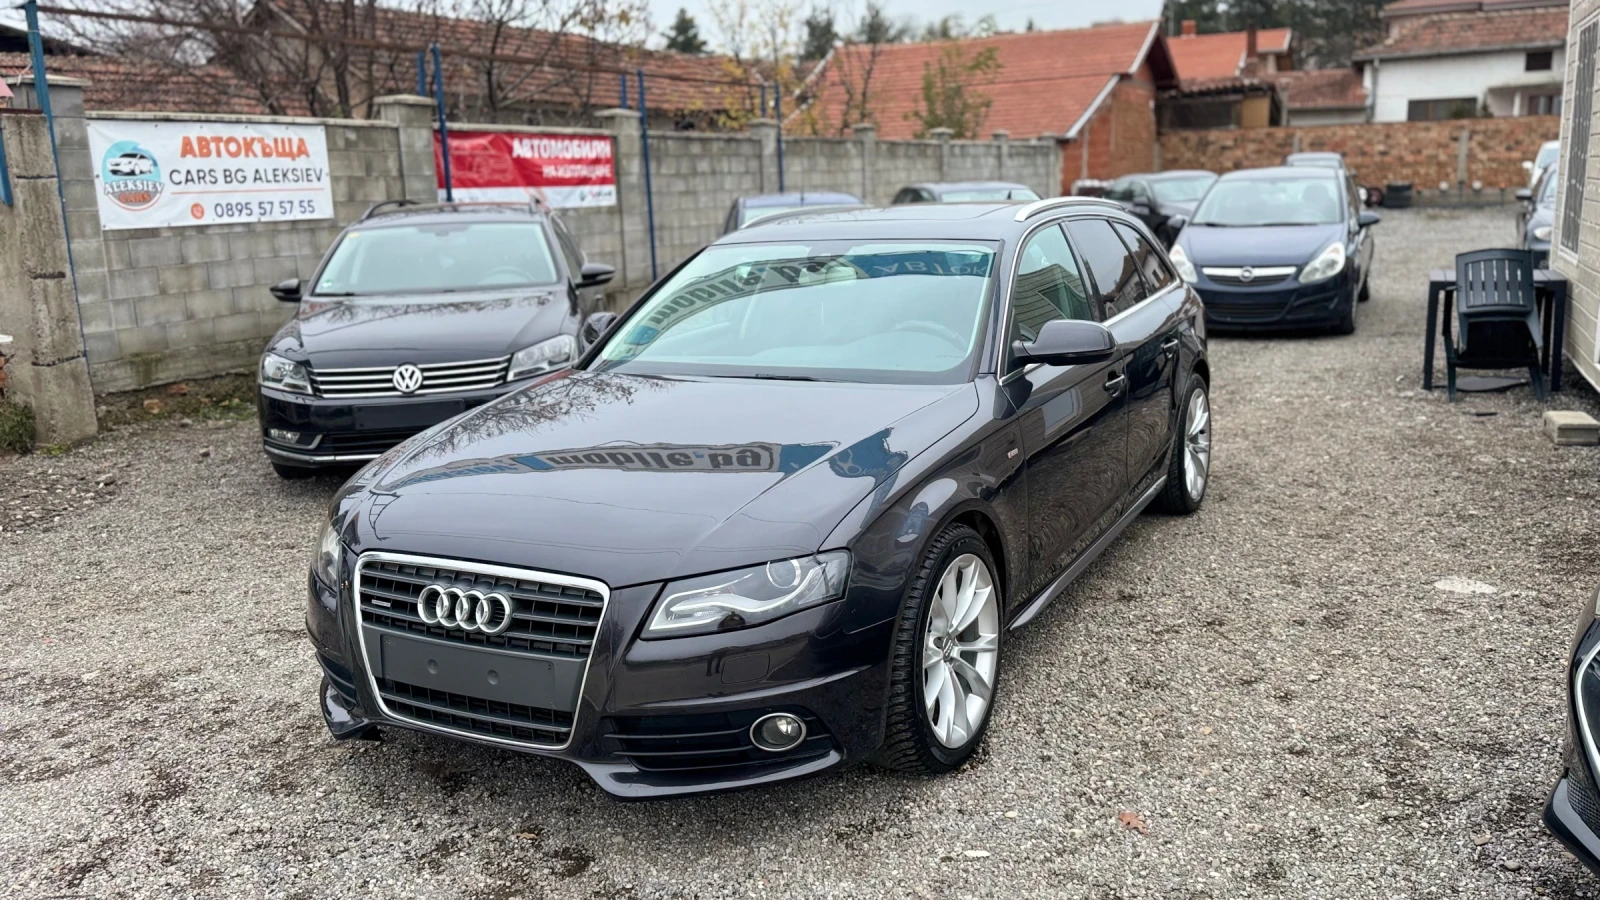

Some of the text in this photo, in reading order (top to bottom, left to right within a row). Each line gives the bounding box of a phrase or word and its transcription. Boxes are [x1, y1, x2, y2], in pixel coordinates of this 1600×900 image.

[180, 136, 310, 161] АВТОКЪЩА
[512, 138, 611, 159] АВТОМОБИЛИ
[169, 168, 323, 186] CARS BG ALEKSIEV
[104, 179, 164, 195] ALEKSIEV
[118, 191, 151, 203] CARS
[214, 200, 316, 218] 0895 57 57 55
